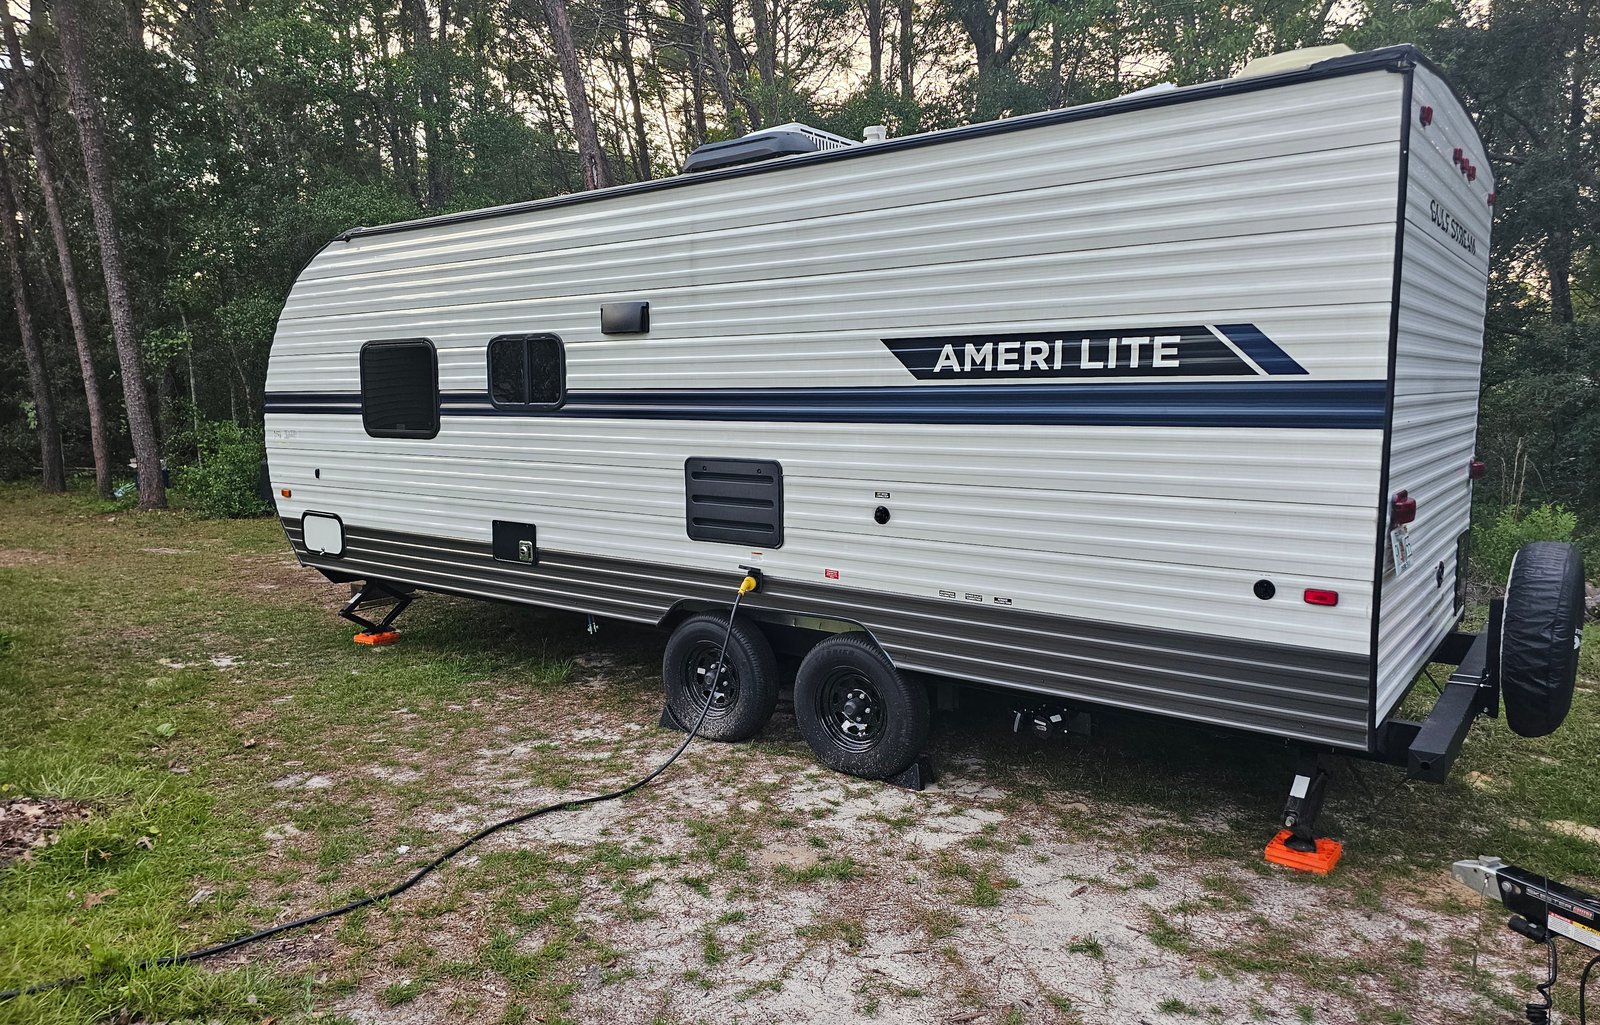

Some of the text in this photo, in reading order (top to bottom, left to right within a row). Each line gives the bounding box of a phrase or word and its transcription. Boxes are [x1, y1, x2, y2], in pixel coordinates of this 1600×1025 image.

[1430, 199, 1477, 256] GULF STREAM
[932, 335, 1182, 373] AMERI LITE
